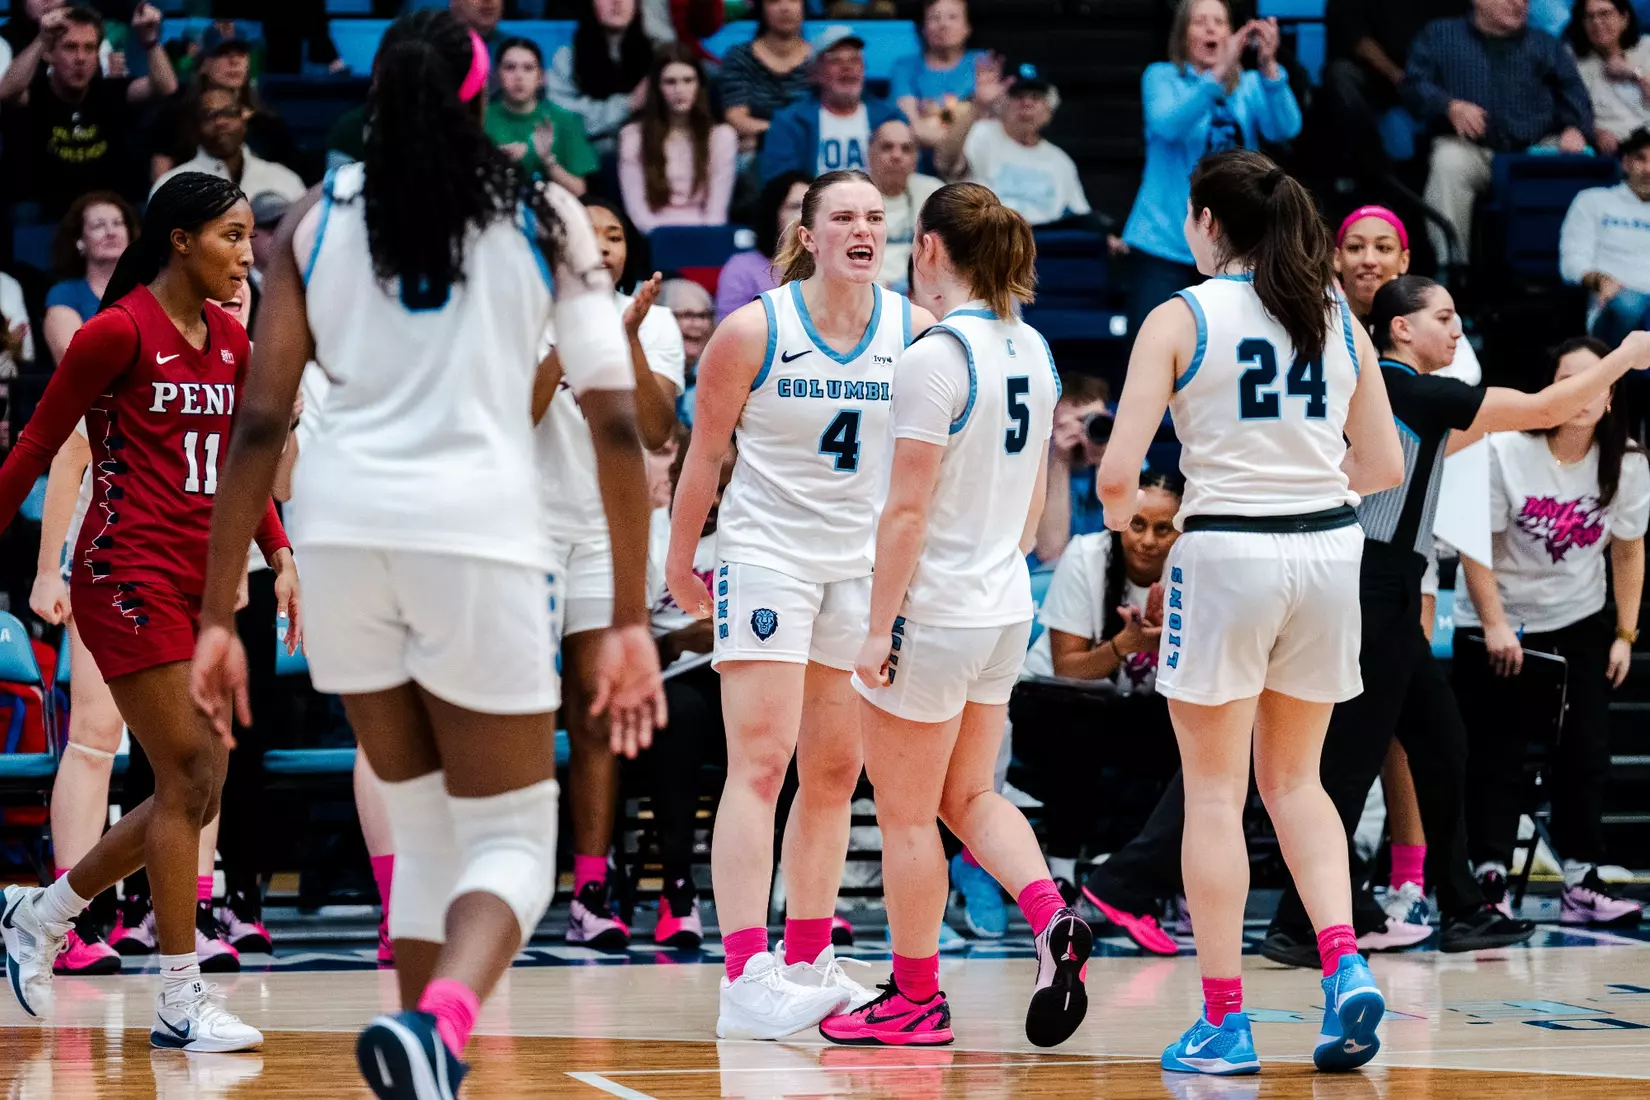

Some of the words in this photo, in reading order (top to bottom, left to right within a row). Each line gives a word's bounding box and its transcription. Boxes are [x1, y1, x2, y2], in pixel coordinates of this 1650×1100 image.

[778, 378, 893, 401] COLUMBI
[1004, 375, 1030, 455] 5
[1236, 337, 1327, 420] 24
[184, 431, 220, 494] 11
[818, 409, 861, 472] 4
[718, 561, 729, 639] IONS
[1166, 566, 1183, 669] LIONS
